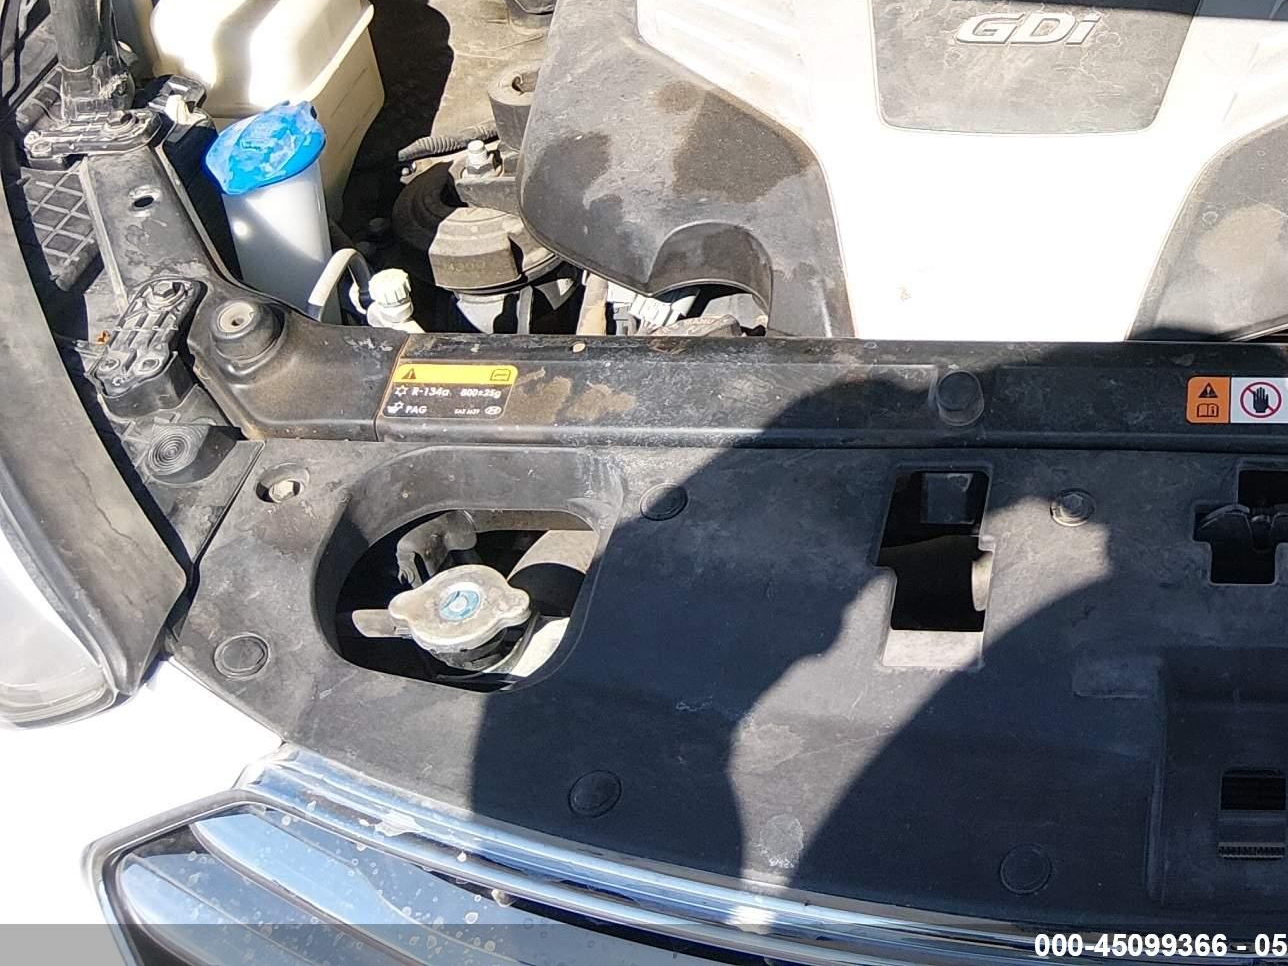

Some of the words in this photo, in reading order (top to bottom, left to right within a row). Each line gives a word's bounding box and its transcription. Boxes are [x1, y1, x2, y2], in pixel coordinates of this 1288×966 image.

[956, 12, 1102, 46] GDi
[411, 386, 450, 397] R-134a
[405, 405, 428, 414] PAG
